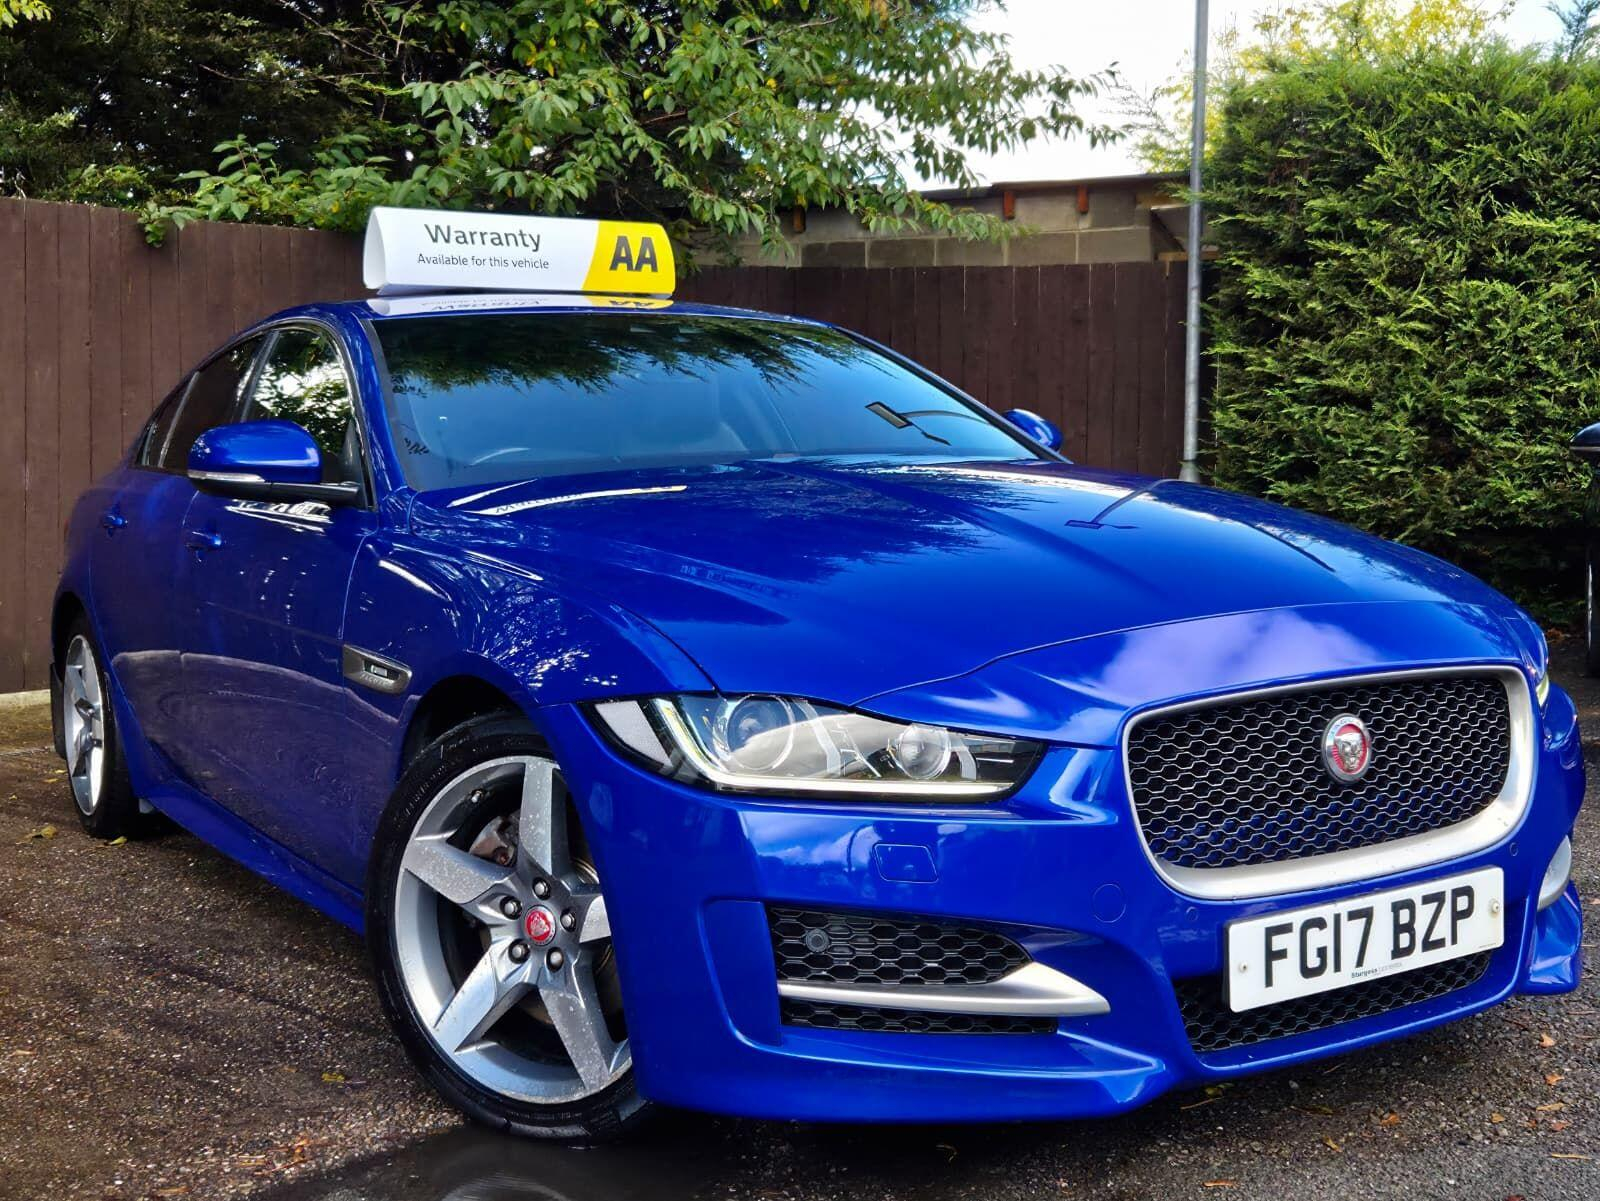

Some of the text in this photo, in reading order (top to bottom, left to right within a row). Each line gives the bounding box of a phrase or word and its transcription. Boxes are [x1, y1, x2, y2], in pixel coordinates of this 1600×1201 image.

[424, 224, 541, 253] Warranty
[609, 235, 658, 273] AA
[418, 253, 550, 270] Available for this vehicle
[1264, 885, 1475, 989] FG17 BZP
